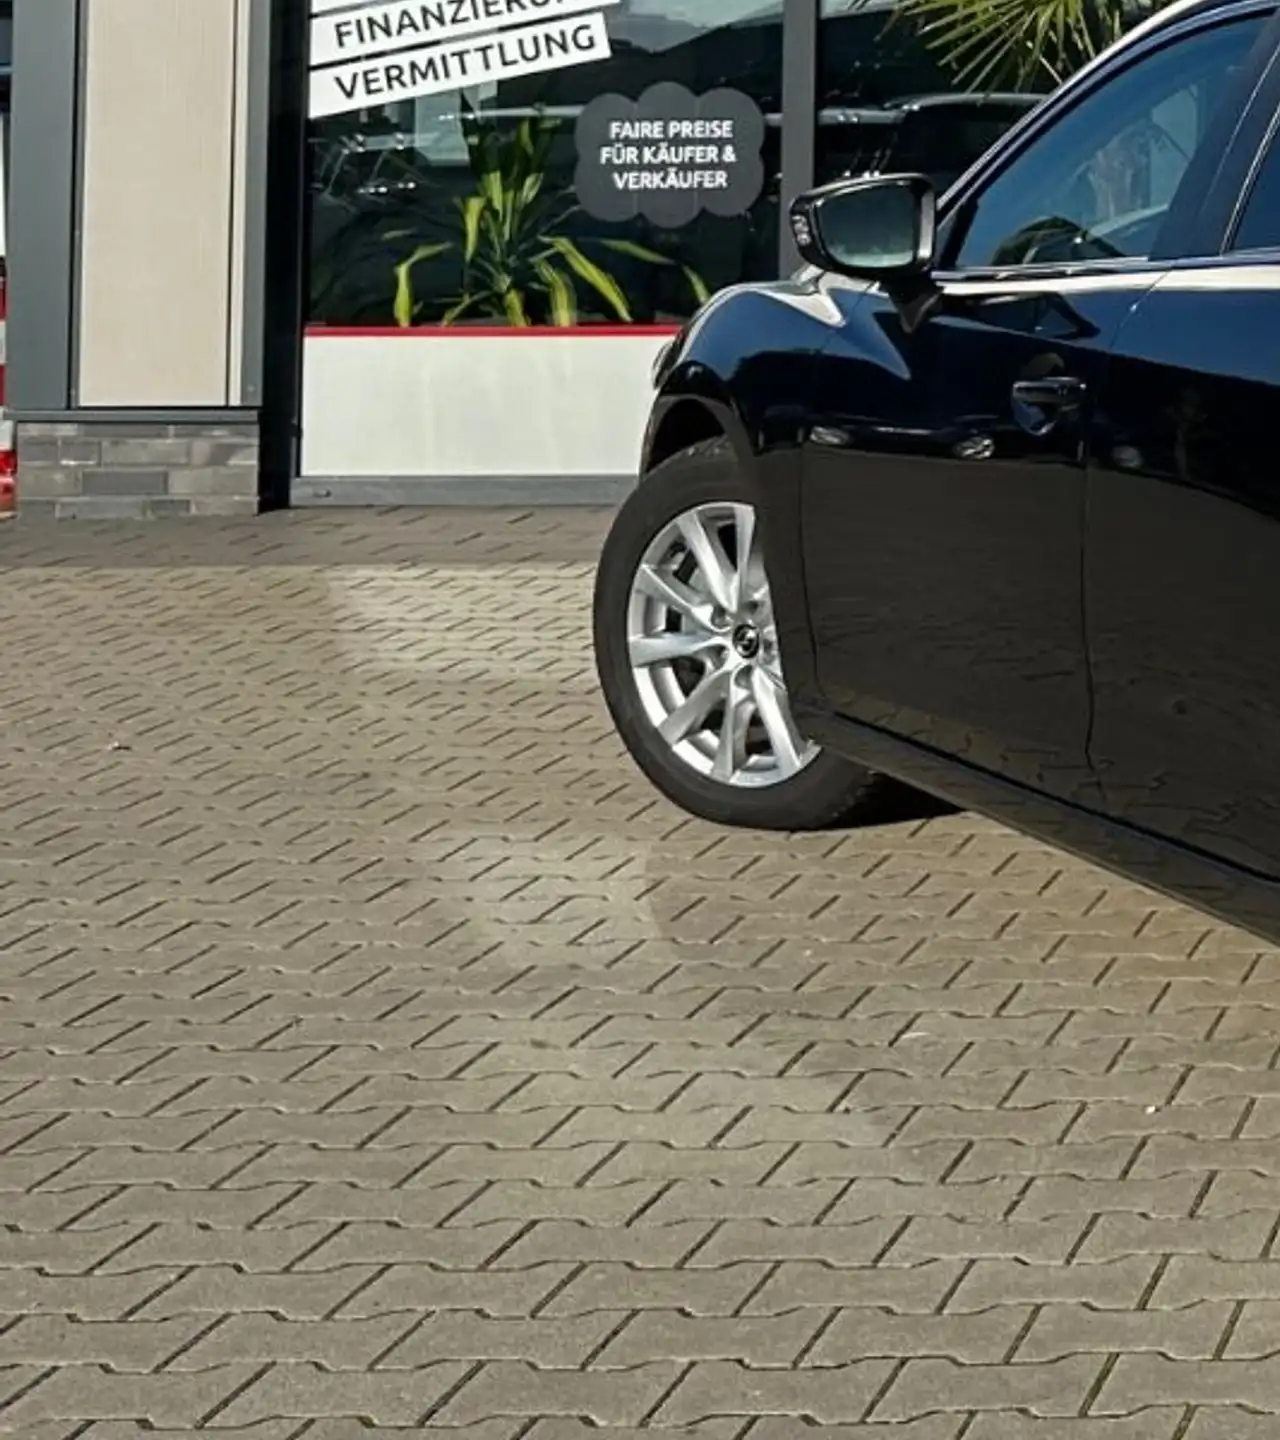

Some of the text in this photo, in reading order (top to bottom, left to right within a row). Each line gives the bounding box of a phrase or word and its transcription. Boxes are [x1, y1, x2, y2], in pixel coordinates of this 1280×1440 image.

[334, 24, 597, 100] VERMITTLUNG
[610, 120, 733, 139] FAIRE PREISE
[600, 141, 736, 164] FÜR KÄUFER &
[612, 167, 728, 190] VERKÄUFER
